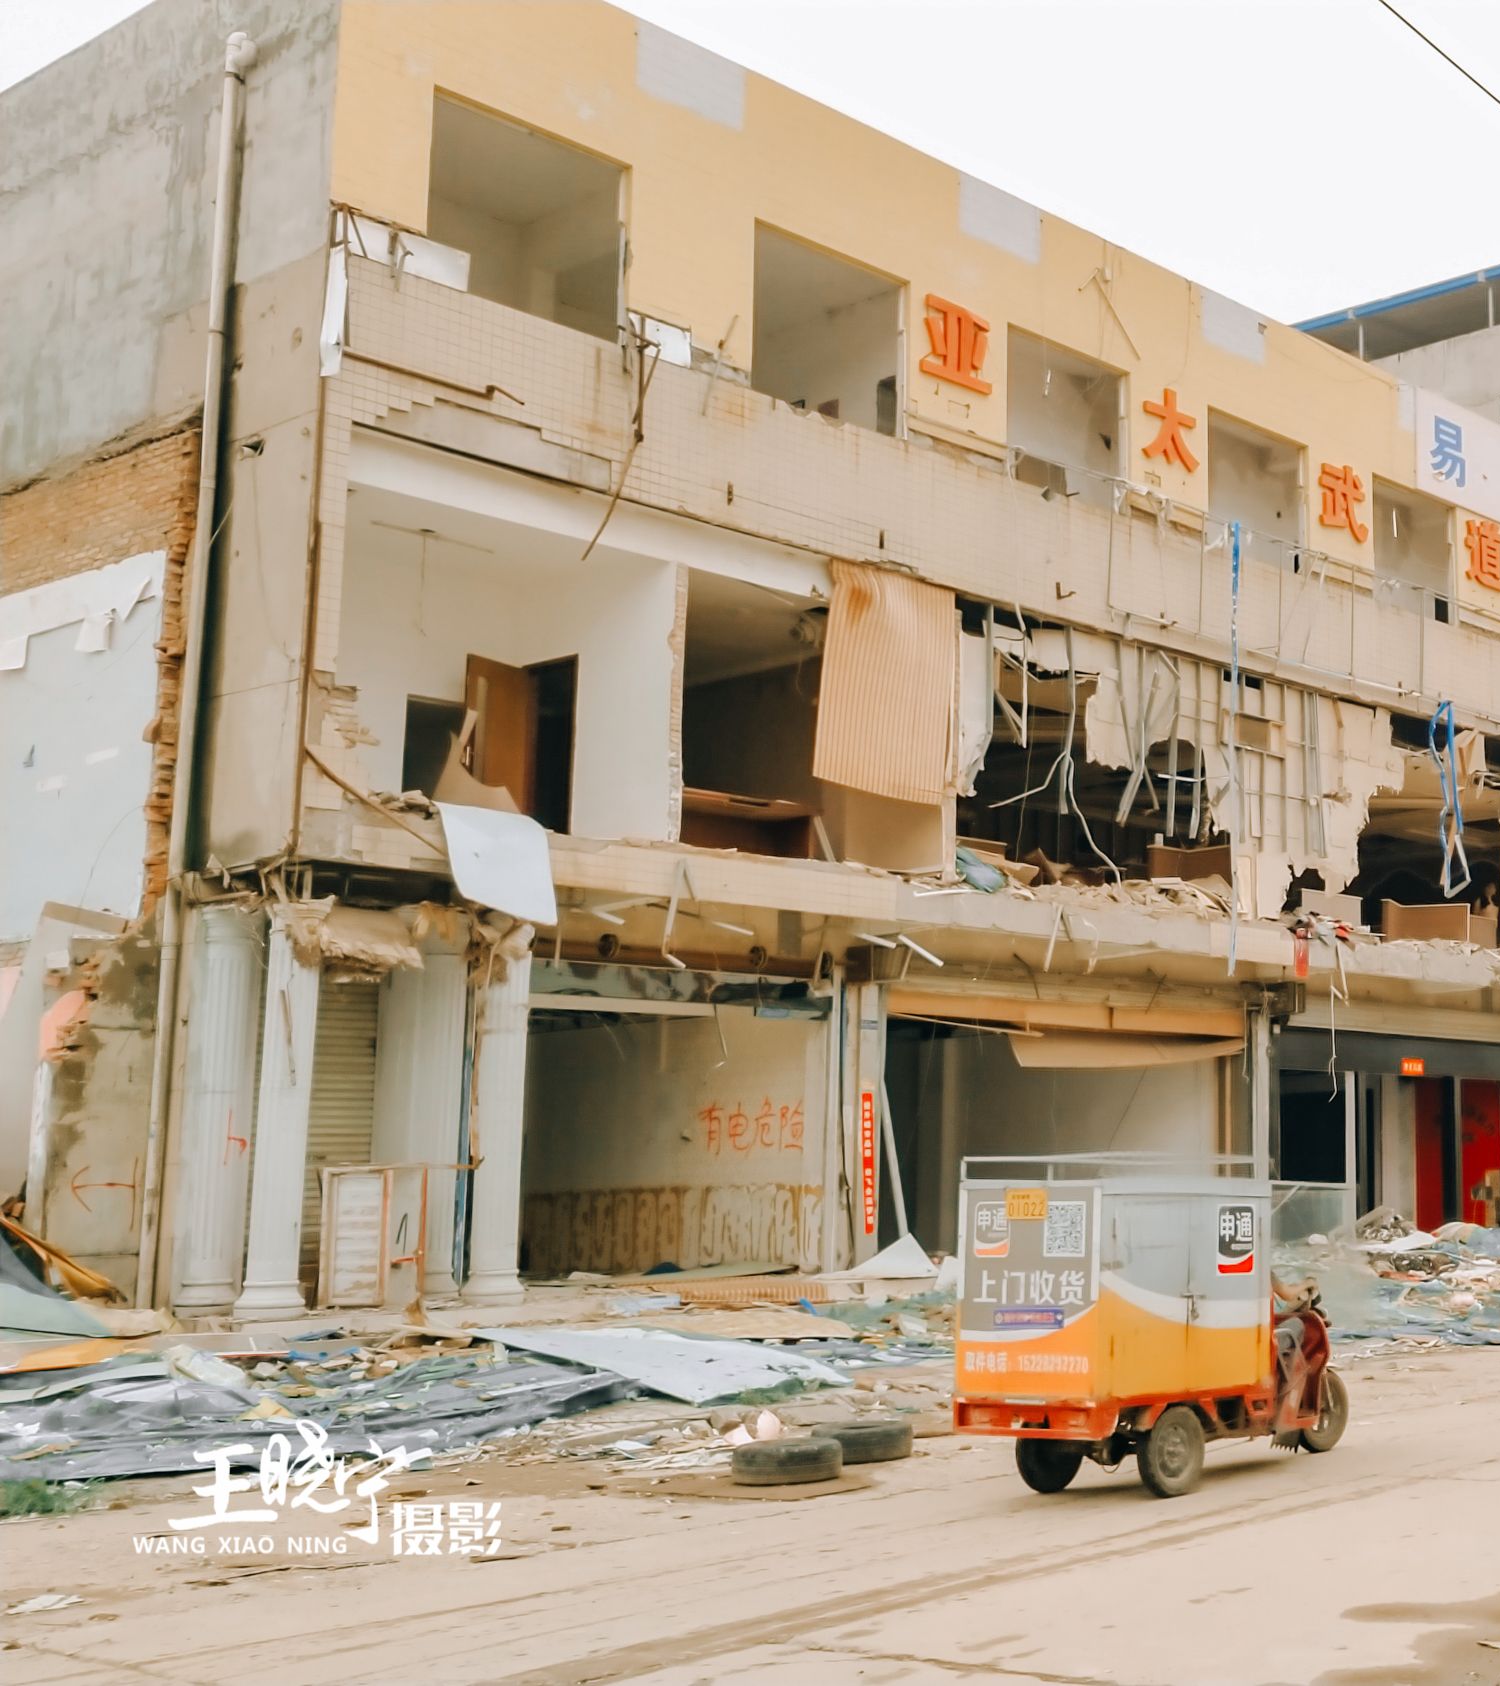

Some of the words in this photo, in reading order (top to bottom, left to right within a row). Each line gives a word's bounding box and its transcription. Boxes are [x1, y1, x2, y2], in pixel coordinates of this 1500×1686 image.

[1429, 415, 1468, 488] 易
[699, 1097, 804, 1155] 有电危险
[978, 1208, 1007, 1232] 申通
[1008, 1202, 1044, 1217] 01022
[1220, 1210, 1253, 1242] 申通
[973, 1270, 1085, 1305] 上门收货
